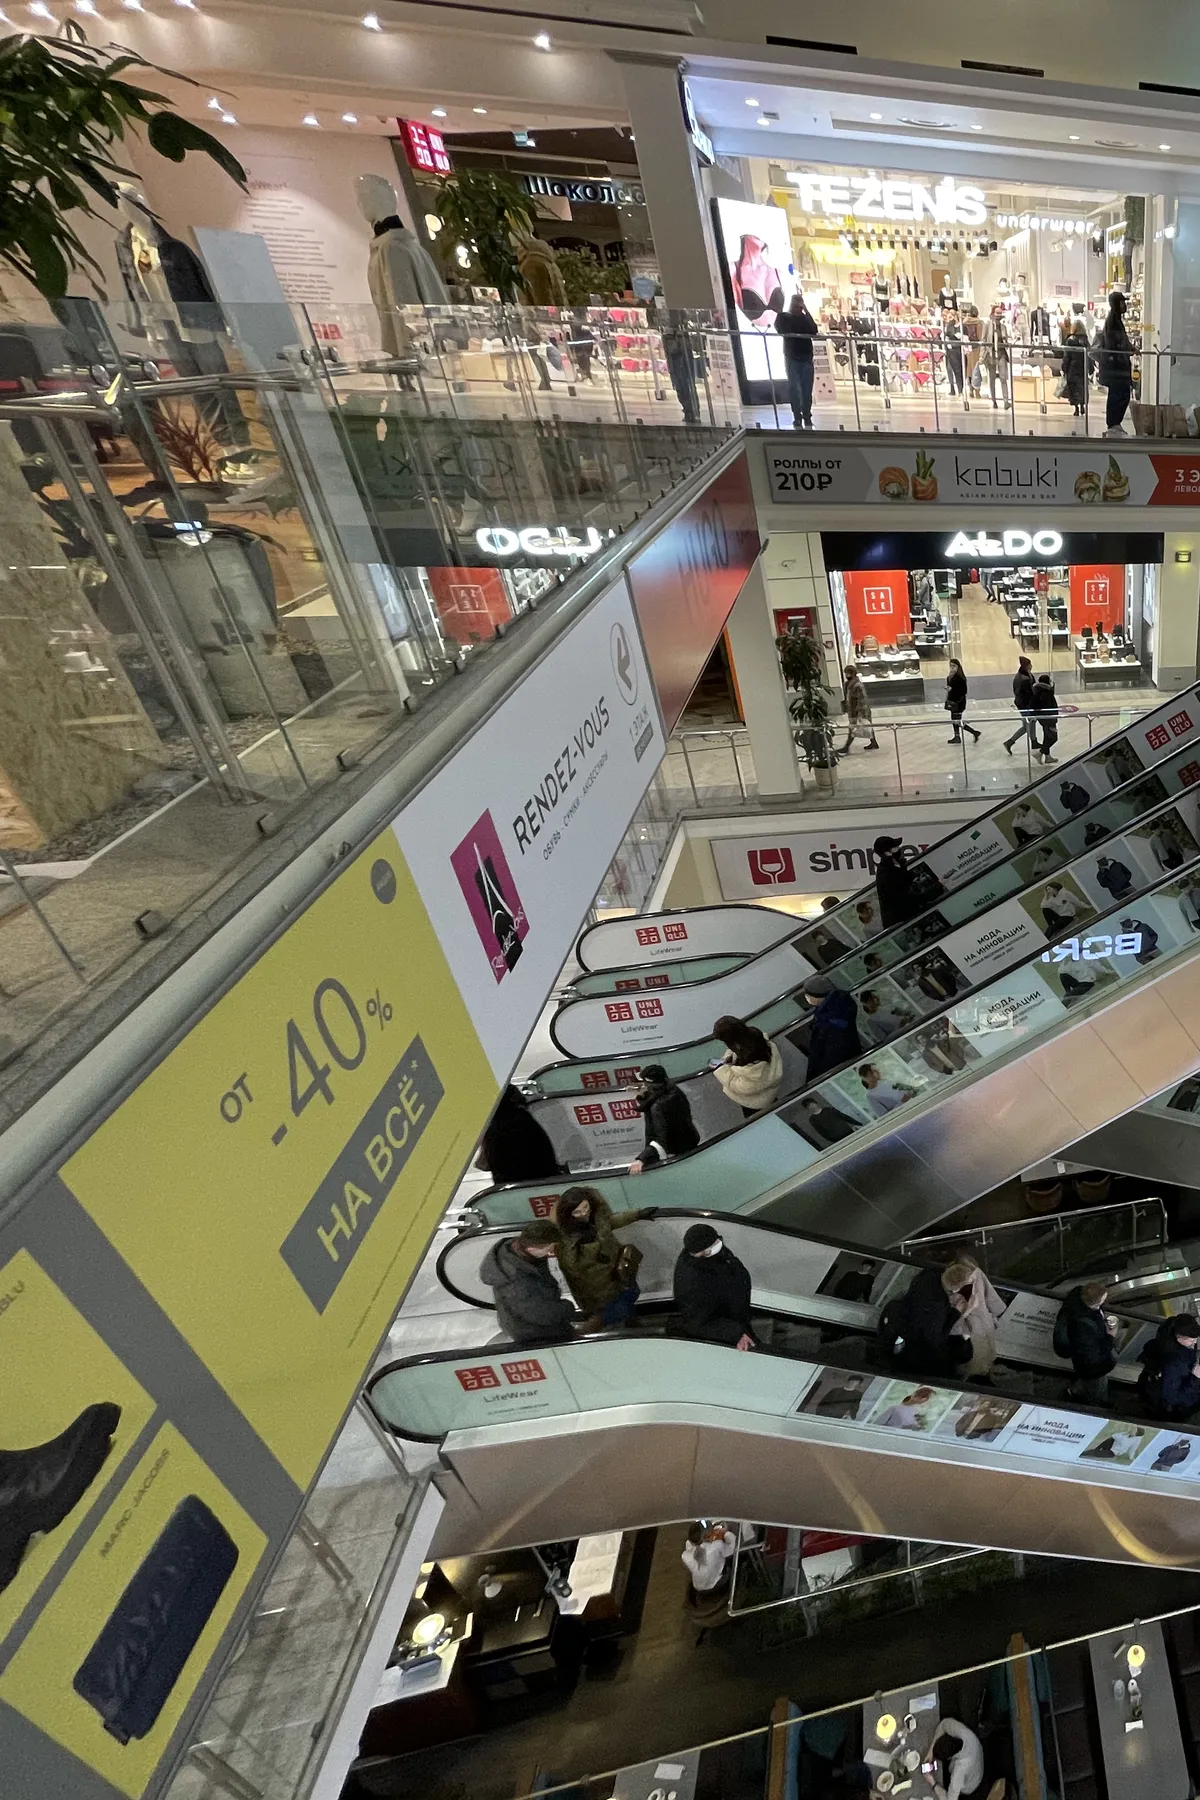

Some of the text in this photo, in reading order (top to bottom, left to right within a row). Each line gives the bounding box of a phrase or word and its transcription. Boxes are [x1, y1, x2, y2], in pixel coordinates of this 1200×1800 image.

[996, 213, 1095, 236] underwear
[773, 459, 842, 470] РОЛЛЫ ОТ
[955, 456, 1058, 488] kabuki
[1175, 469, 1186, 484] 3
[944, 530, 1063, 558] ALDO
[1170, 713, 1187, 727] UNI
[1174, 720, 1191, 735] QLO
[512, 695, 610, 855] RENDEZ-VOUS
[956, 841, 1000, 869] ИННОВАЦИИ
[957, 845, 980, 860] МОДА
[973, 892, 996, 908] МОДА
[665, 925, 683, 933] UNI
[667, 932, 686, 940] QLO
[976, 928, 1002, 945] МОДА
[963, 953, 977, 963] НА
[976, 923, 1026, 955] ИННОВАЦИИ
[638, 1000, 658, 1009] UNI
[987, 995, 1015, 1014] МОДА
[641, 1008, 661, 1017] QLO
[620, 1024, 658, 1034] LifeWear
[220, 1072, 254, 1124] ОТ
[315, 1180, 373, 1263] НА
[506, 1362, 534, 1373] UNI
[483, 1389, 539, 1403] LifeWear
[1031, 1425, 1086, 1439] ИННОВАЦИИ
[1043, 1420, 1070, 1430] МОДА
[100, 1448, 170, 1559] MARC JACOBS
